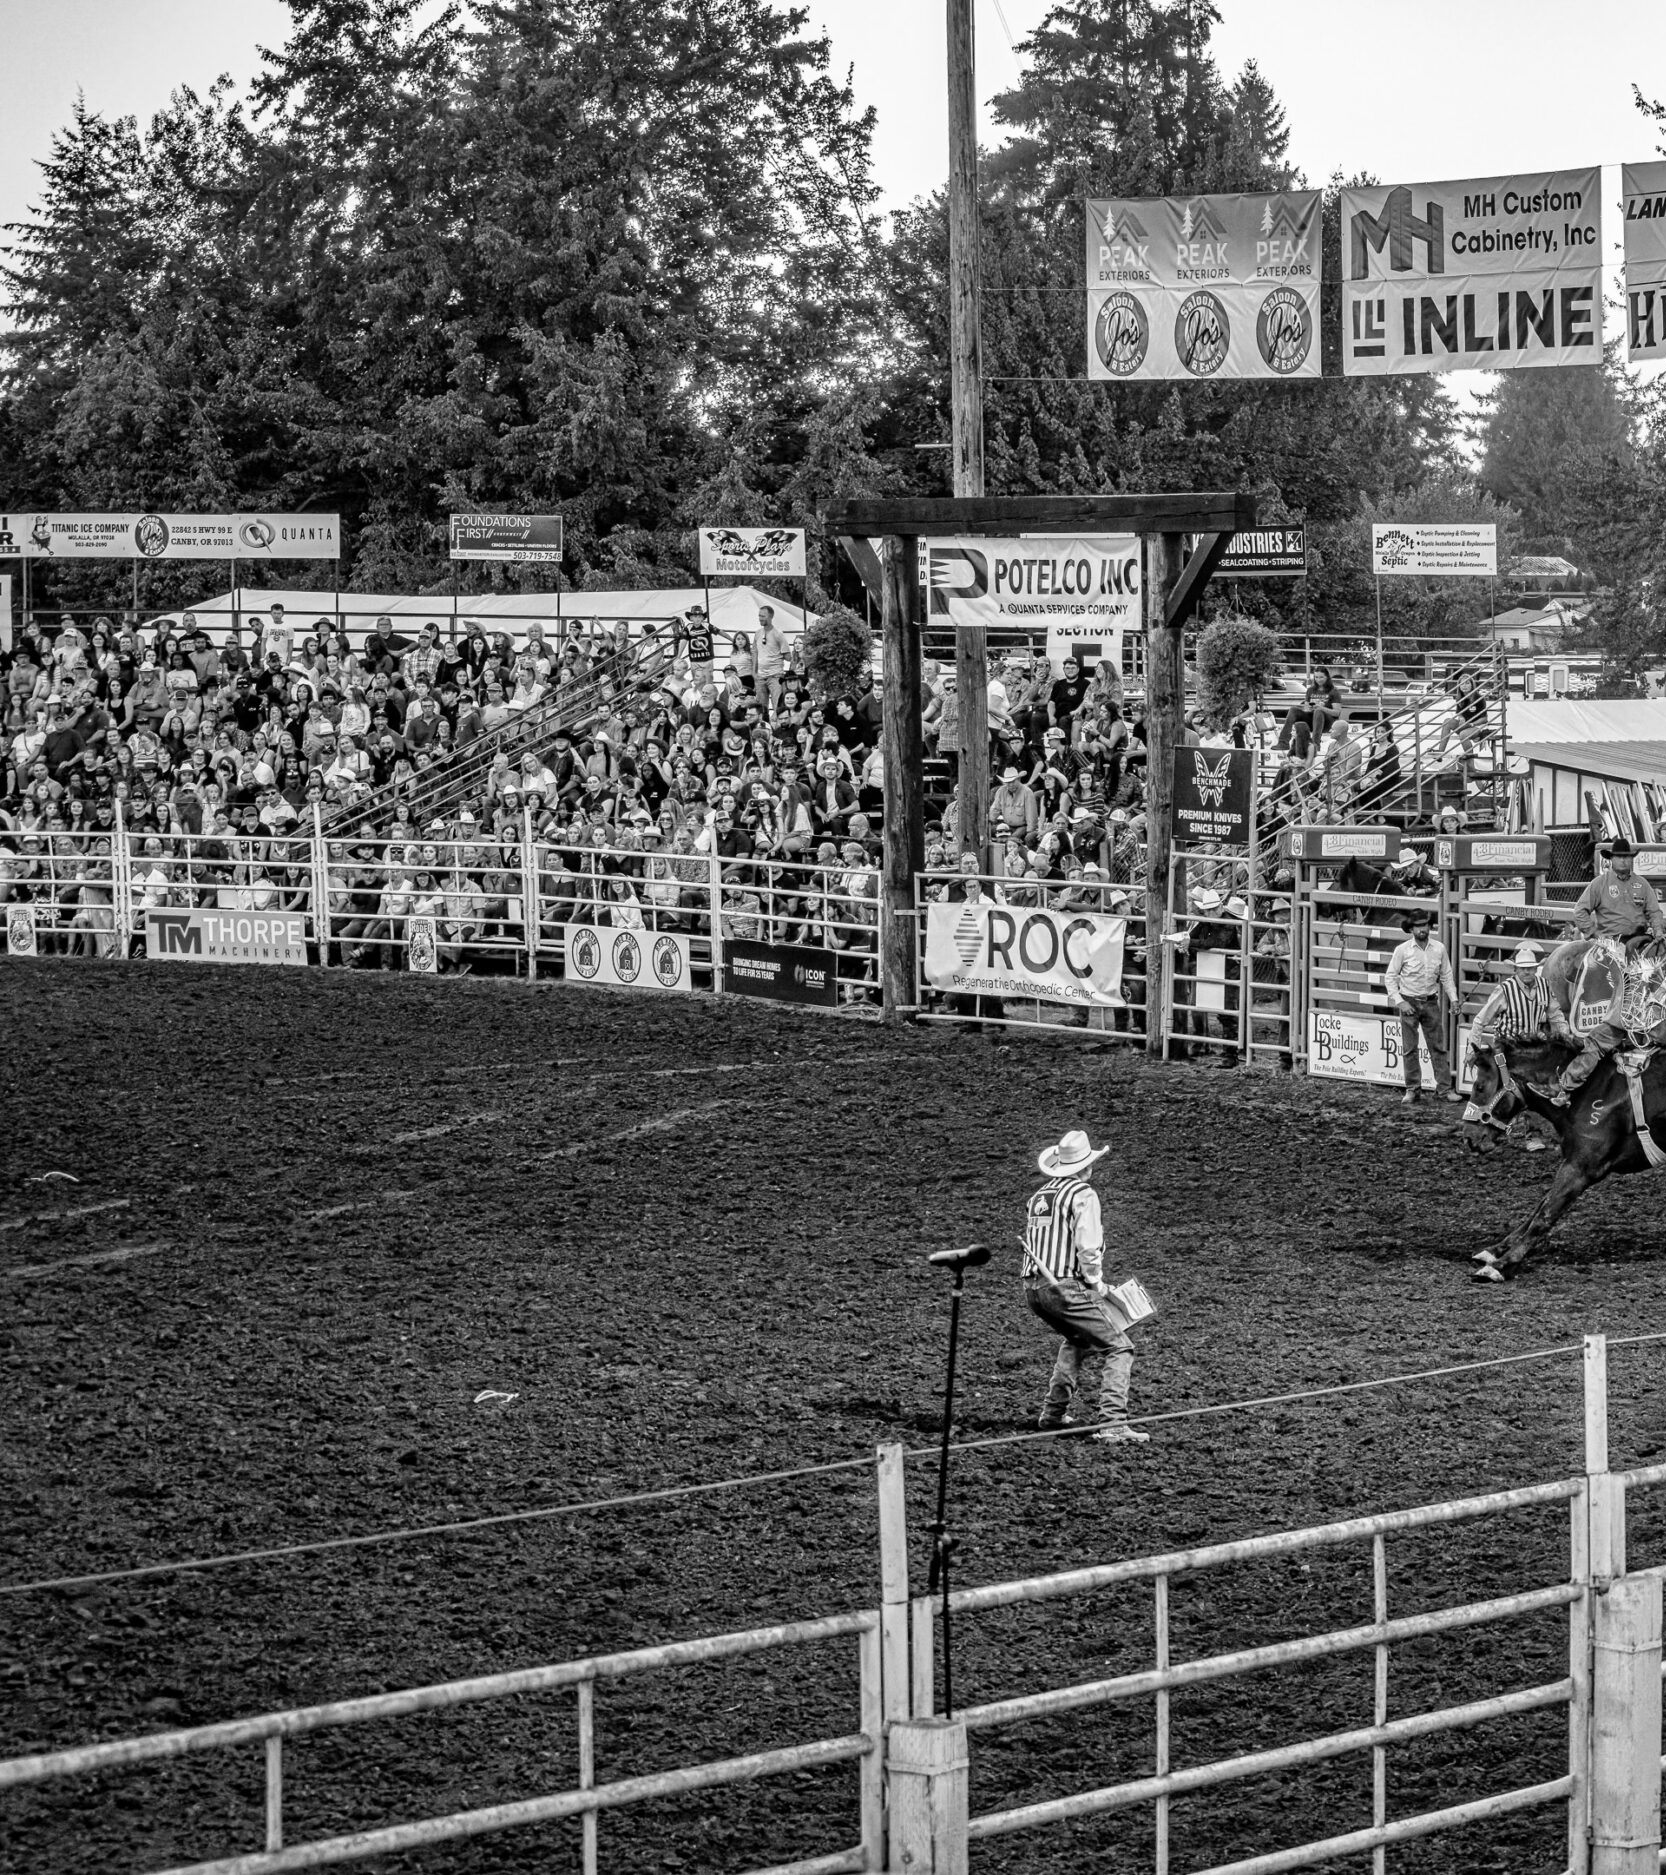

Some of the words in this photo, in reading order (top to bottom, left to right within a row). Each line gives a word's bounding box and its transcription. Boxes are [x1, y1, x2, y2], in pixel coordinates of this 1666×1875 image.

[1464, 194, 1496, 218] MH
[1503, 190, 1582, 214] Custom
[1451, 227, 1558, 254] Cabinetry,
[1564, 223, 1596, 246] Inc
[1099, 245, 1150, 267] PEAK
[1177, 242, 1229, 265] PEAK
[1256, 238, 1309, 263] PEAK
[1099, 271, 1150, 281] EXTERIORS
[1177, 268, 1230, 279] EXTERIORS
[1100, 296, 1134, 319] Saloon
[1180, 295, 1215, 318] Saloon
[1261, 292, 1297, 315] Saloon
[1403, 286, 1594, 355] INLINE
[1106, 310, 1143, 366] Jo's
[1186, 309, 1224, 366] Jo's
[1268, 307, 1307, 364] Jo's
[1119, 350, 1143, 372] Eatery
[1199, 350, 1224, 373] Eatery
[1281, 347, 1306, 370] Eatery
[51, 524, 78, 533] TITANIC
[81, 524, 92, 533] ICE
[95, 524, 130, 533] COMPANY
[171, 526, 192, 534] 22842
[193, 526, 198, 534] S
[199, 526, 216, 534] HWY
[217, 526, 225, 534] 99
[227, 526, 233, 534] E
[281, 528, 333, 541] QUANTA
[452, 516, 531, 536] FOUNDATIONS
[171, 538, 198, 547] CANBY,
[200, 538, 211, 547] OR
[213, 538, 234, 546] 97013
[754, 535, 793, 556] Plaza
[1375, 530, 1415, 549] Bennett
[513, 552, 561, 560] 503-719-7548
[716, 558, 790, 574] Motorcycles
[1272, 557, 1304, 566] STRIPING
[1381, 555, 1408, 568] Septic
[994, 558, 1092, 595] POTELCO
[1100, 558, 1139, 595] INC
[999, 604, 1005, 614] A
[1007, 603, 1046, 614] QUANTA
[1047, 604, 1086, 614] SERVICES
[1088, 604, 1128, 615] COMPANY
[1192, 777, 1231, 787] BENCHMADE
[1178, 809, 1212, 821] PREMIUM
[1214, 812, 1242, 823] KNIVES
[1189, 822, 1213, 834] SINCE
[1214, 824, 1232, 835] 1987
[1505, 906, 1528, 917] CANBY
[1530, 908, 1554, 919] RODEO
[149, 914, 201, 954] TM
[203, 917, 301, 946] THORPE
[208, 946, 303, 959] MACHINERY
[988, 910, 1096, 978] ROC
[806, 969, 825, 980] ICON
[1009, 980, 1062, 995] Orthopedic
[1581, 1005, 1608, 1016] CANBY
[1312, 1013, 1342, 1043] Locke
[1582, 1016, 1603, 1027] RODE
[1380, 1020, 1402, 1050] Lock
[1317, 1031, 1369, 1061] Buildings
